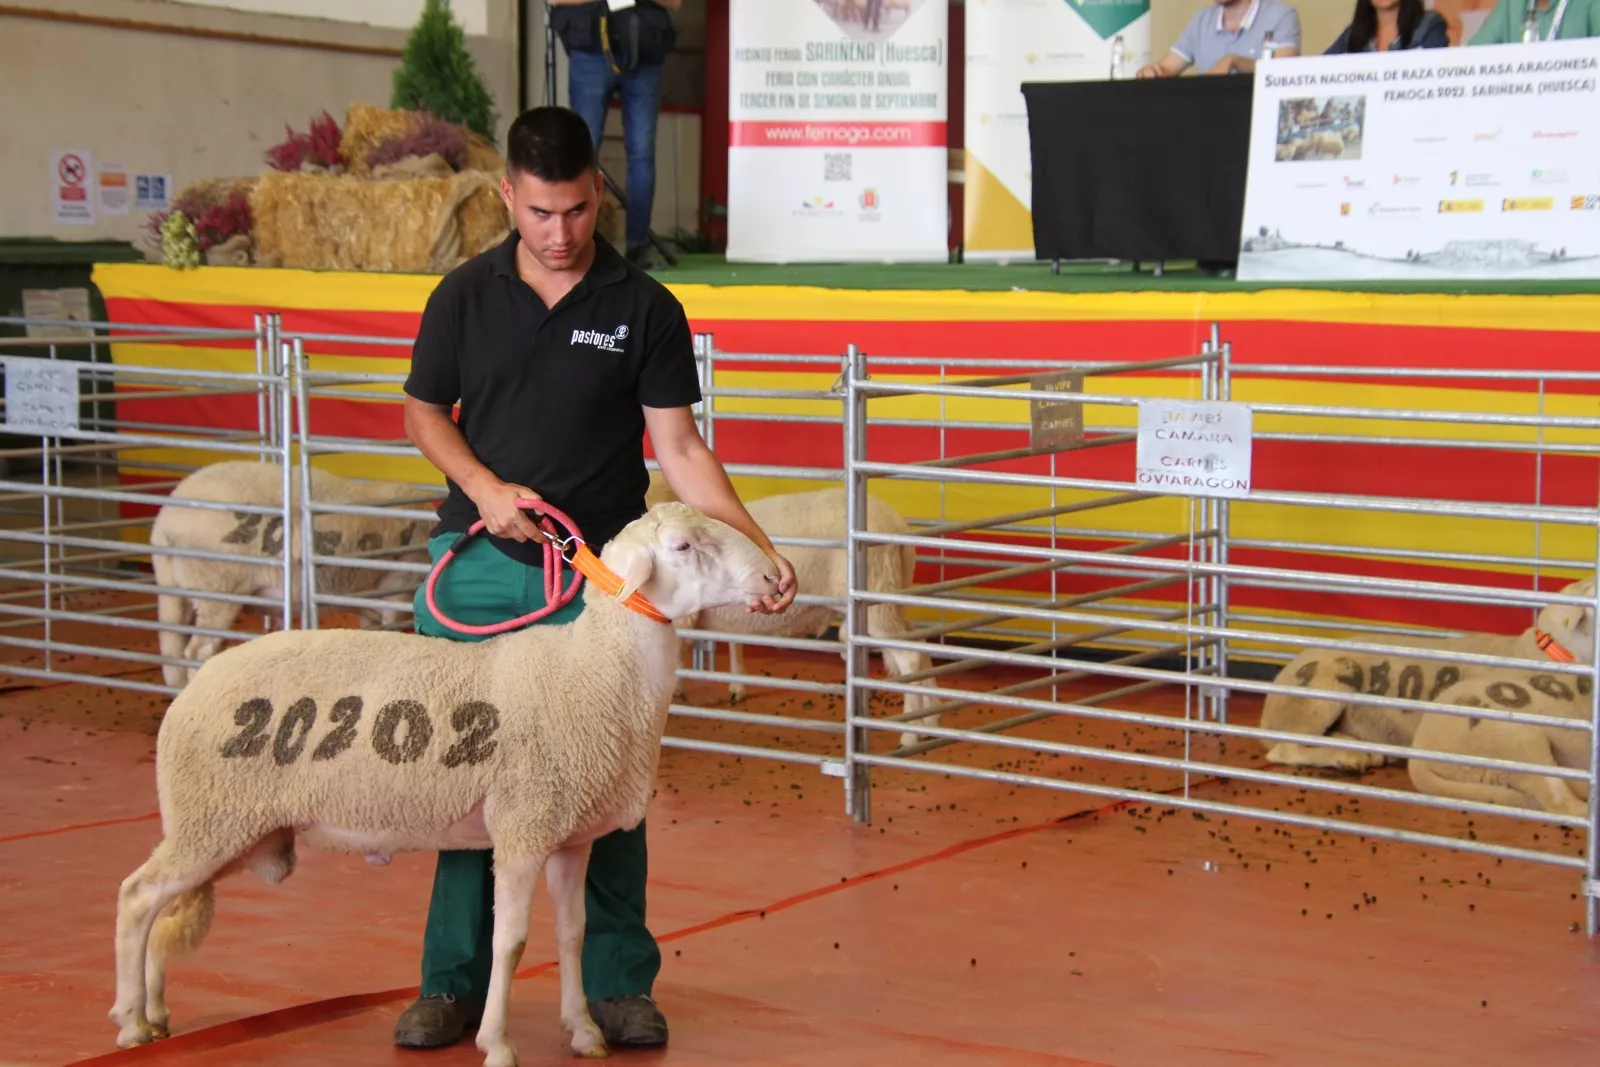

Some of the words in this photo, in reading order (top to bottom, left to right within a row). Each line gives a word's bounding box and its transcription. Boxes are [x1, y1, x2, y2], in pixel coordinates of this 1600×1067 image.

[806, 39, 876, 62] SARIÑENA
[880, 38, 943, 66] (Huesca)
[797, 71, 818, 87] CON
[1265, 74, 1317, 87] SUBASTA
[1320, 71, 1380, 85] NACIONAL
[1383, 69, 1398, 81] DE
[1402, 66, 1434, 80] RAZA
[1437, 64, 1476, 79] OVINA
[1479, 62, 1513, 76] RASA
[1517, 56, 1598, 74] ARAGONESA
[1384, 87, 1434, 102] FEMOGA
[1537, 77, 1597, 95] (HUESCA)
[779, 93, 796, 109] FIN
[799, 93, 811, 109] DE
[860, 93, 872, 109] DE
[875, 93, 938, 109] SEPTIEMBRE
[765, 124, 912, 144] www.femoga.com
[570, 329, 616, 348] pastores
[1139, 472, 1249, 491] OVIARAGON
